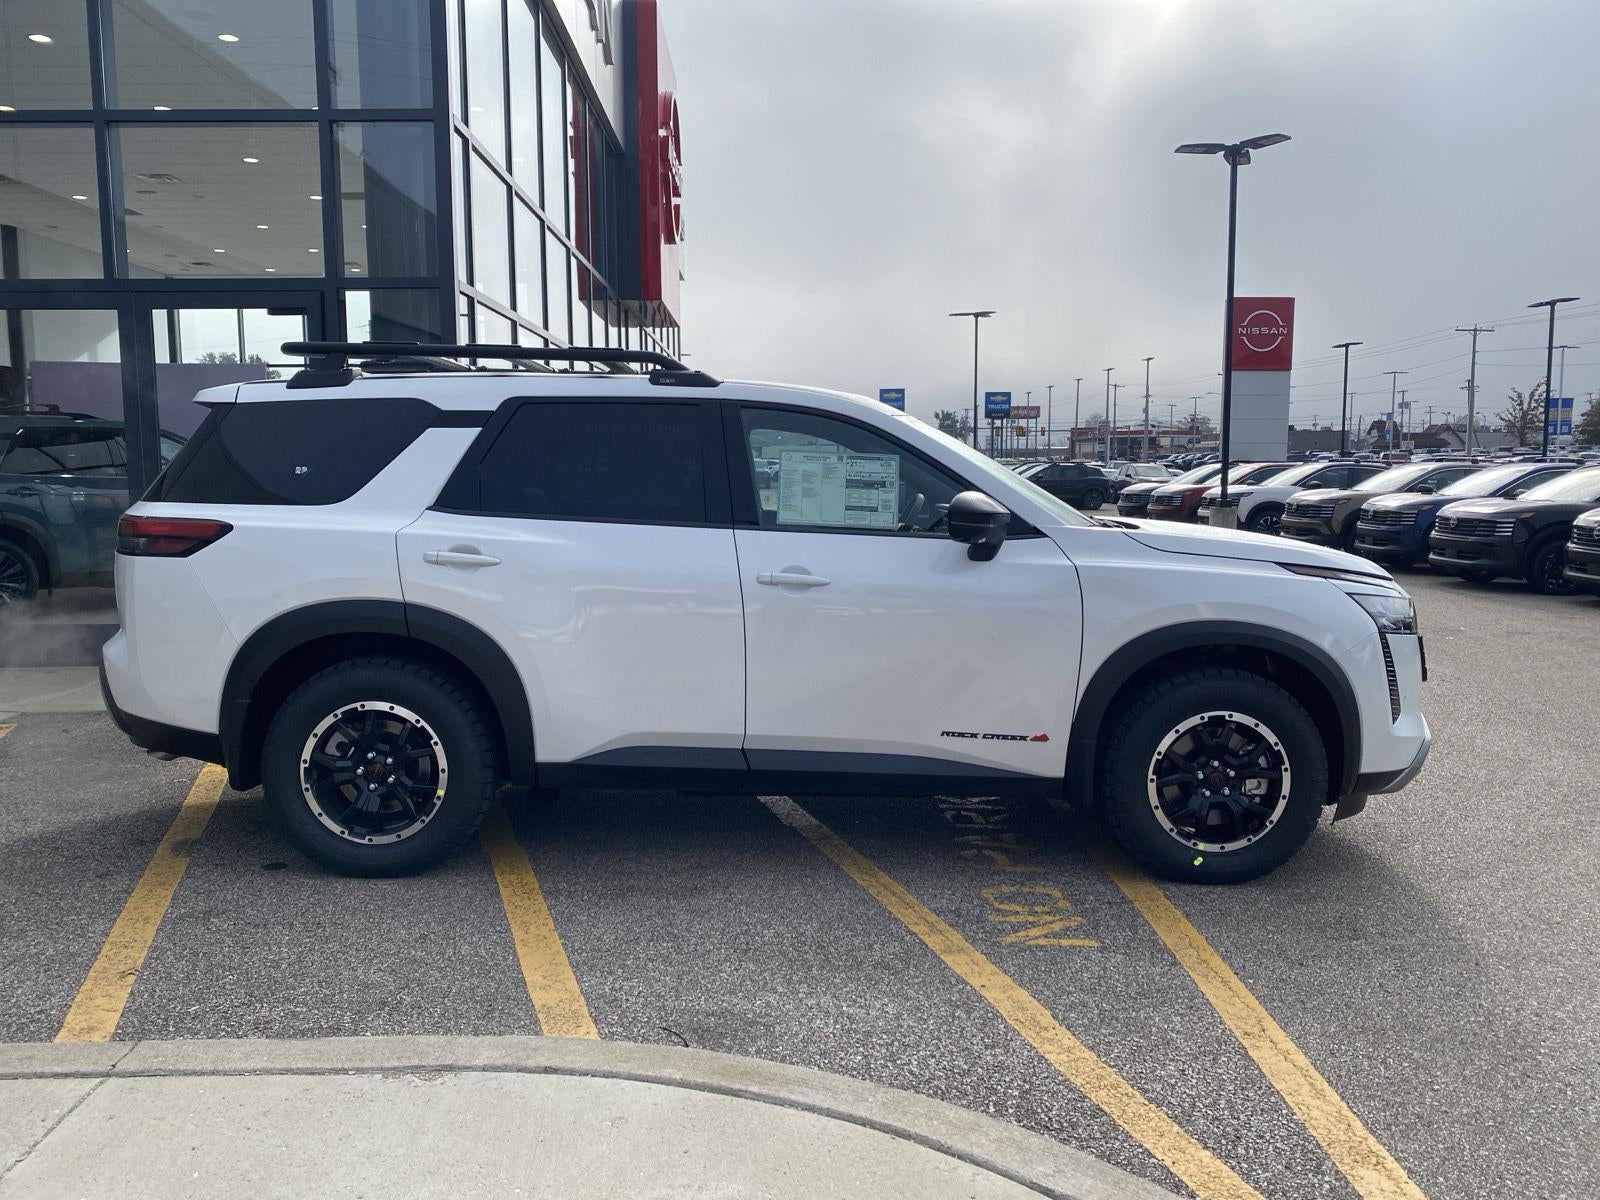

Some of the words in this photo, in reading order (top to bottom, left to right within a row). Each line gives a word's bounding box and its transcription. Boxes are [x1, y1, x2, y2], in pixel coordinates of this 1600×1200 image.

[940, 731, 980, 739] ROCK
[981, 733, 1030, 742] CREEK
[980, 882, 1103, 948] NO
